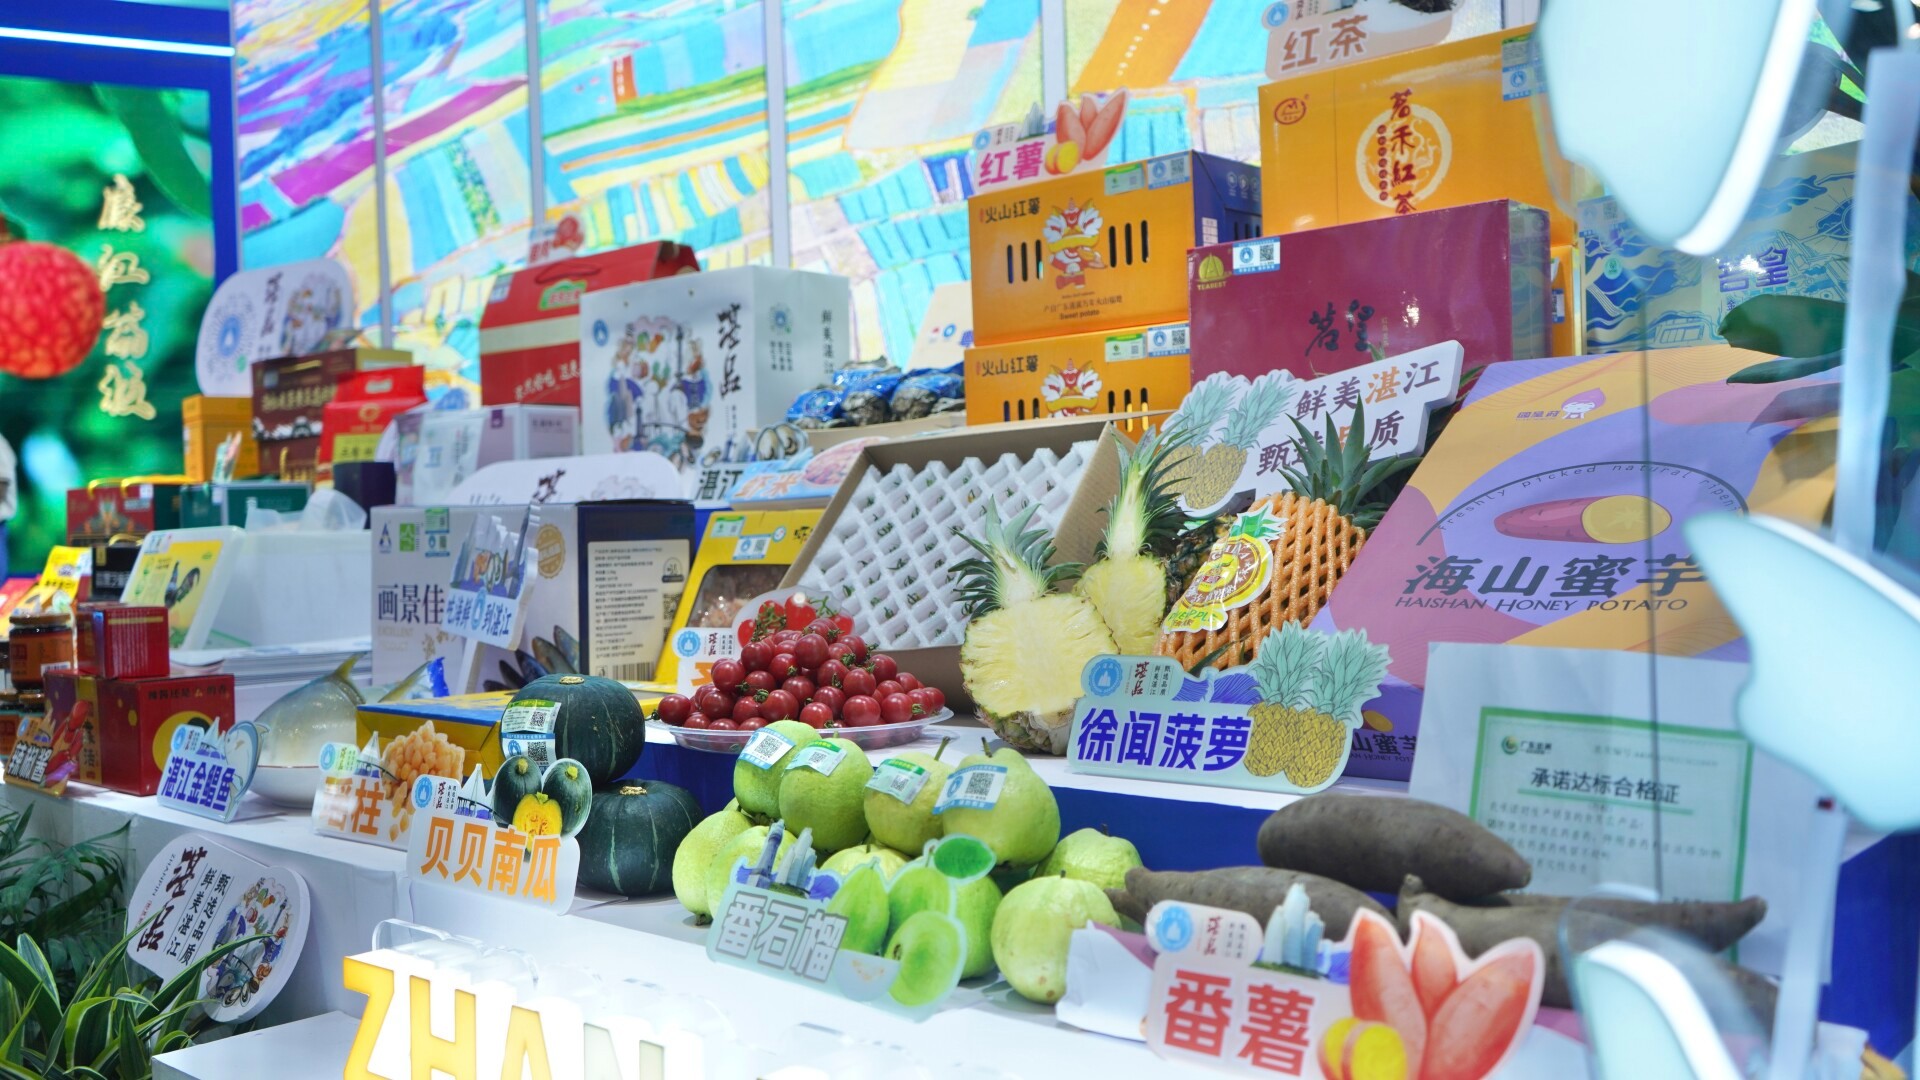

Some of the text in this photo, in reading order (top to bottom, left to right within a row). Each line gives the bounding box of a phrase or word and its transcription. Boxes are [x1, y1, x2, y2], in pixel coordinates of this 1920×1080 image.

[1281, 15, 1368, 71] 红茶
[979, 141, 1045, 187] 红薯
[985, 197, 1040, 224] 火山红薯
[1197, 281, 1227, 290] TEABEST
[982, 355, 1038, 377] 火山红薯
[1296, 361, 1440, 421] 鲜美湛江
[734, 472, 801, 499] 虾米
[1522, 465, 1596, 488] picked
[1612, 464, 1692, 480] natural
[1402, 554, 1708, 598] 海山蜜芋
[377, 583, 444, 625] 画景佳
[1394, 596, 1688, 613] HAISHAN HONEY POTATO
[1077, 707, 1252, 771] 徐闻菠萝
[161, 756, 235, 811] 湛江金鲳鱼
[1530, 766, 1681, 804] 承诺达标合格证
[420, 816, 562, 906] 贝贝南瓜
[166, 867, 218, 957] 鲜美湛江
[180, 873, 232, 966] 甄选品质
[715, 890, 850, 983] 番石榴
[1164, 969, 1315, 1077] 番薯
